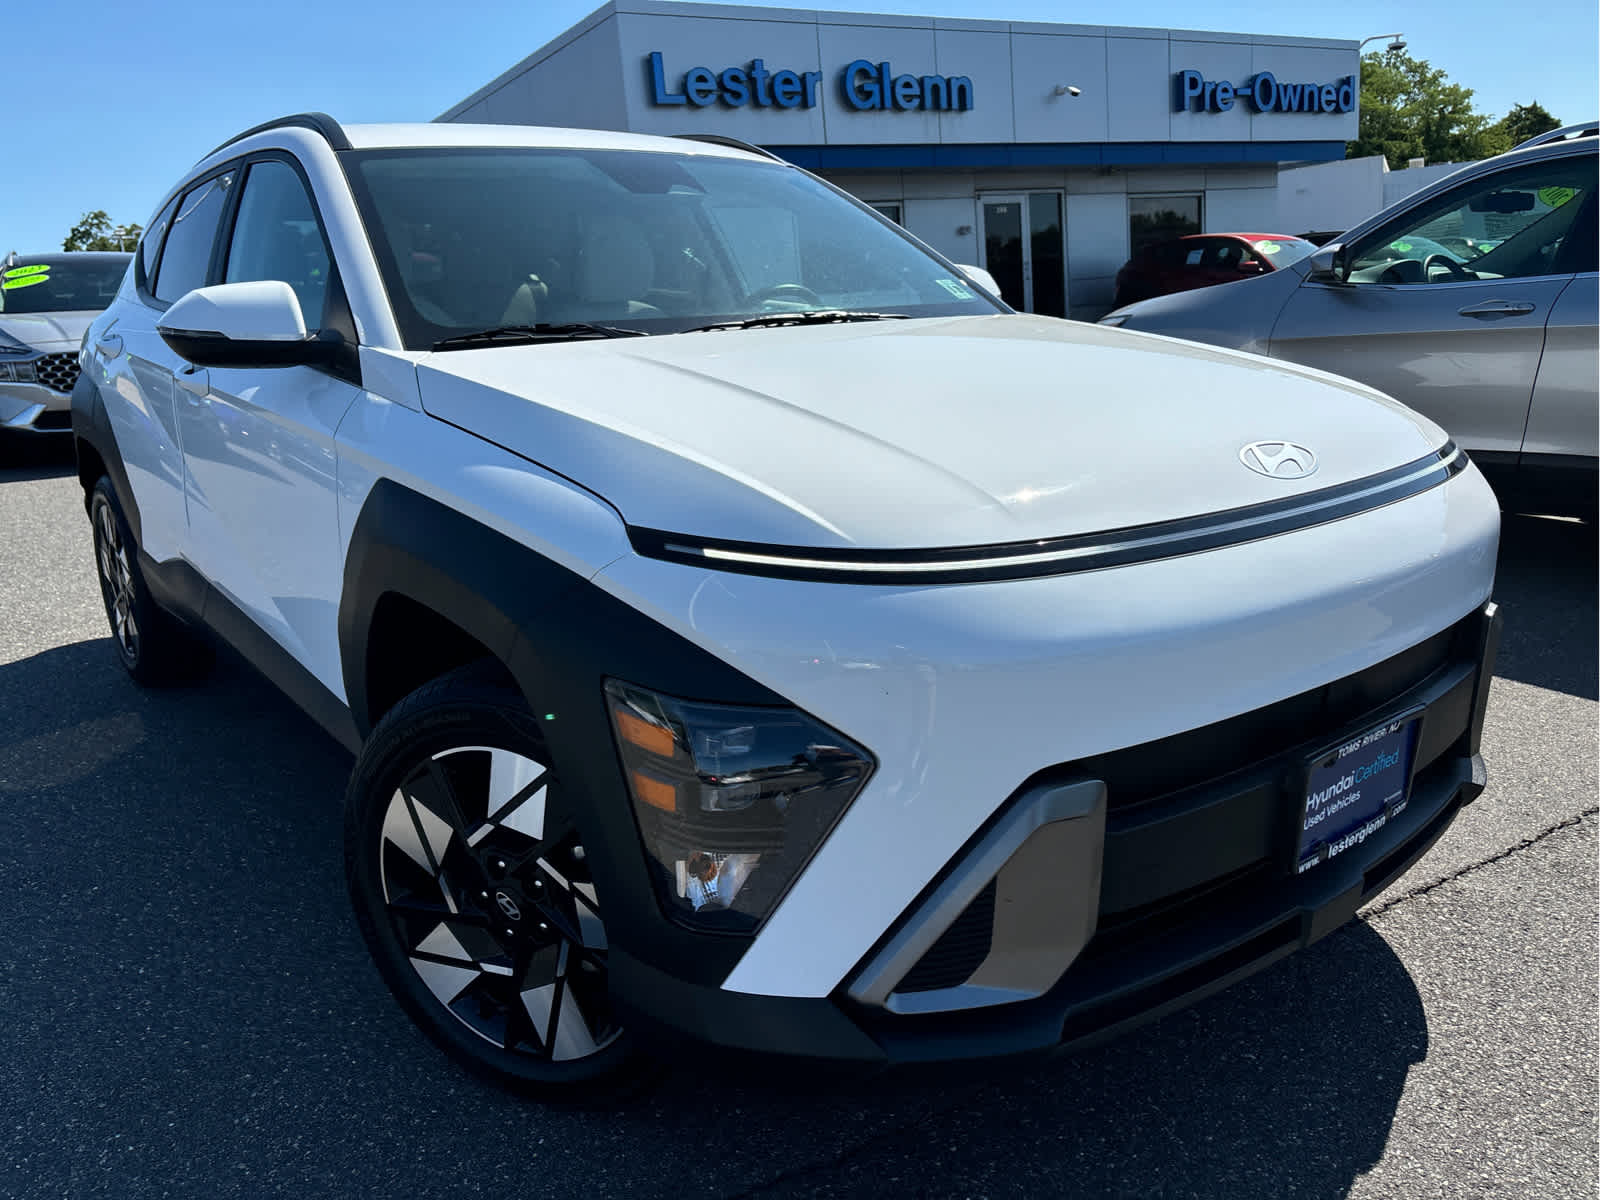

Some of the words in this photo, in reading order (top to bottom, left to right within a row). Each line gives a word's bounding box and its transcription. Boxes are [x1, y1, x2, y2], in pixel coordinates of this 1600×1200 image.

[647, 51, 823, 109] Lester
[842, 59, 975, 112] Glenn
[1173, 70, 1356, 113] Pre-Owned
[1338, 740, 1362, 759] TOMS
[1305, 770, 1356, 812] Hyundai
[1354, 748, 1399, 783] Certified
[1303, 807, 1326, 830] Used
[1326, 790, 1361, 817] Vehicles
[1327, 815, 1386, 859] lesterglenn
